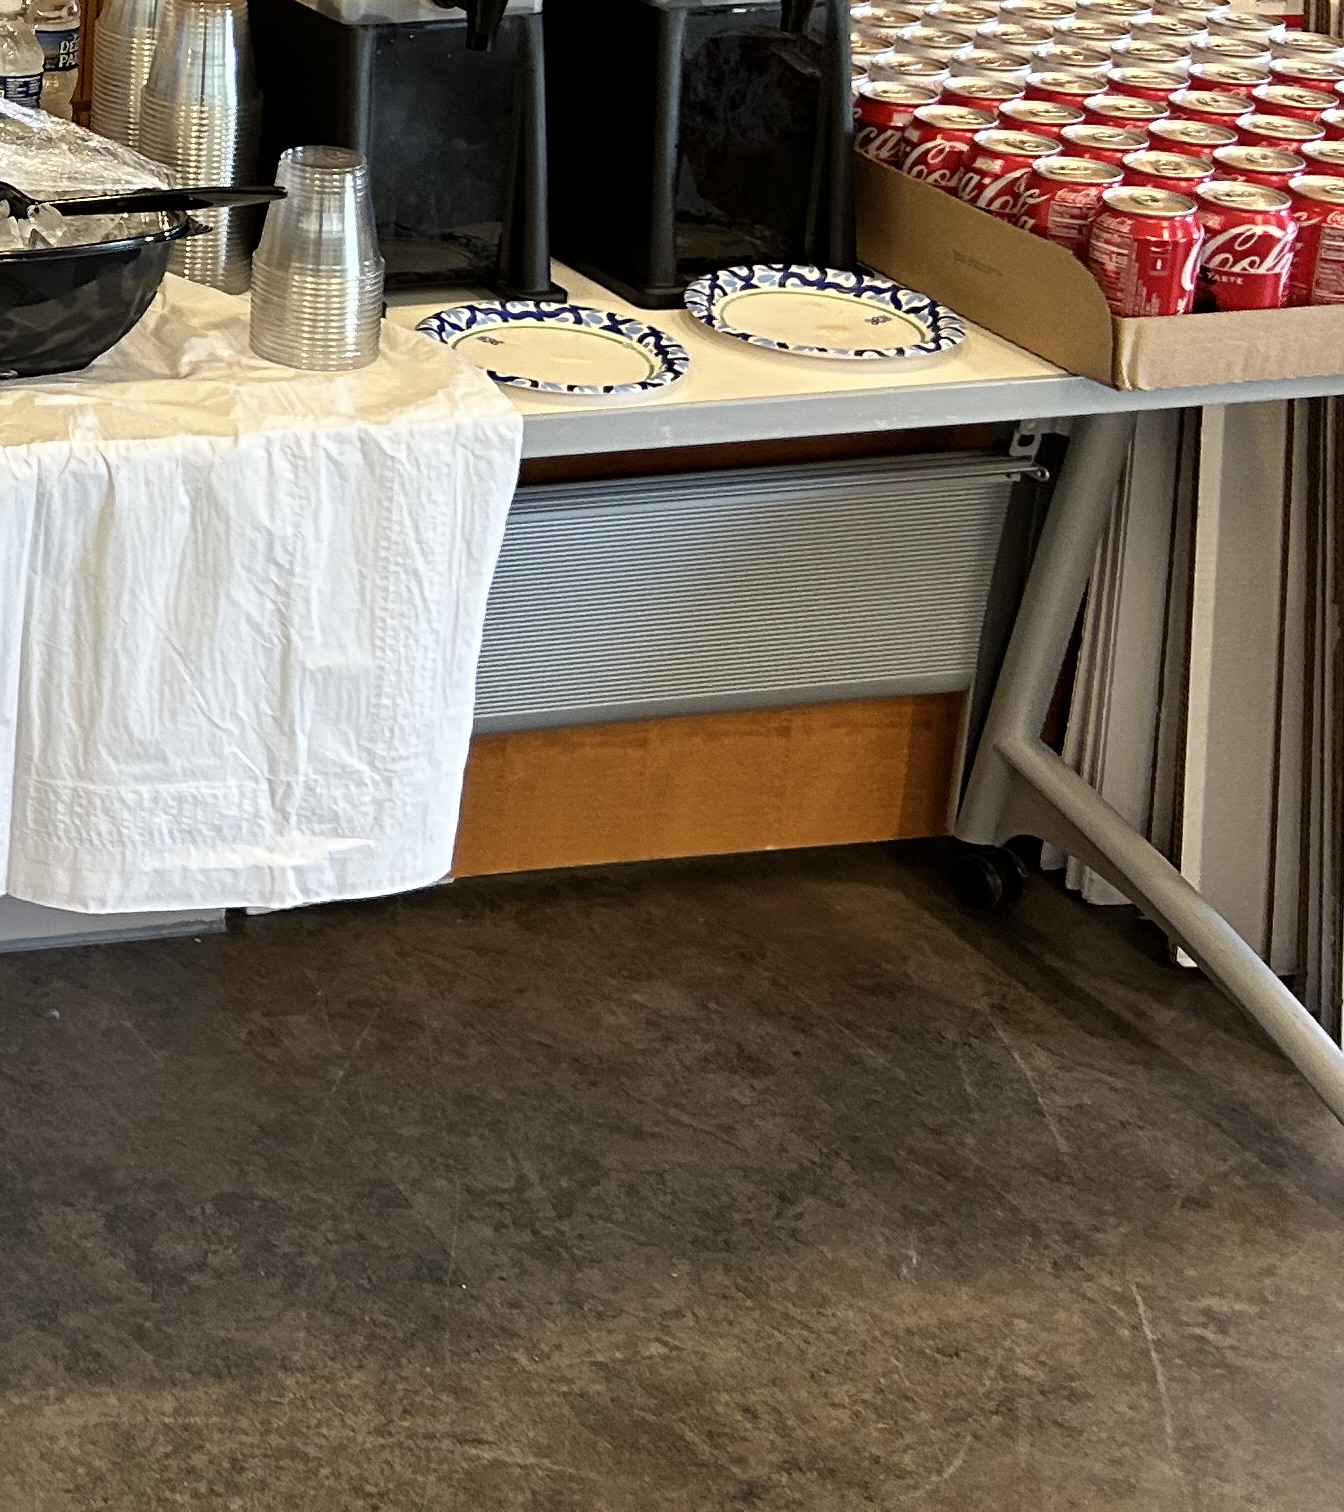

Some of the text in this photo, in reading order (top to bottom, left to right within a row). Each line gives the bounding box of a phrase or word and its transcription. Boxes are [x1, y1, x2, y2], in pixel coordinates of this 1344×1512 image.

[59, 39, 79, 54] DE
[58, 53, 79, 68] PA
[1205, 270, 1244, 286] TASTE
